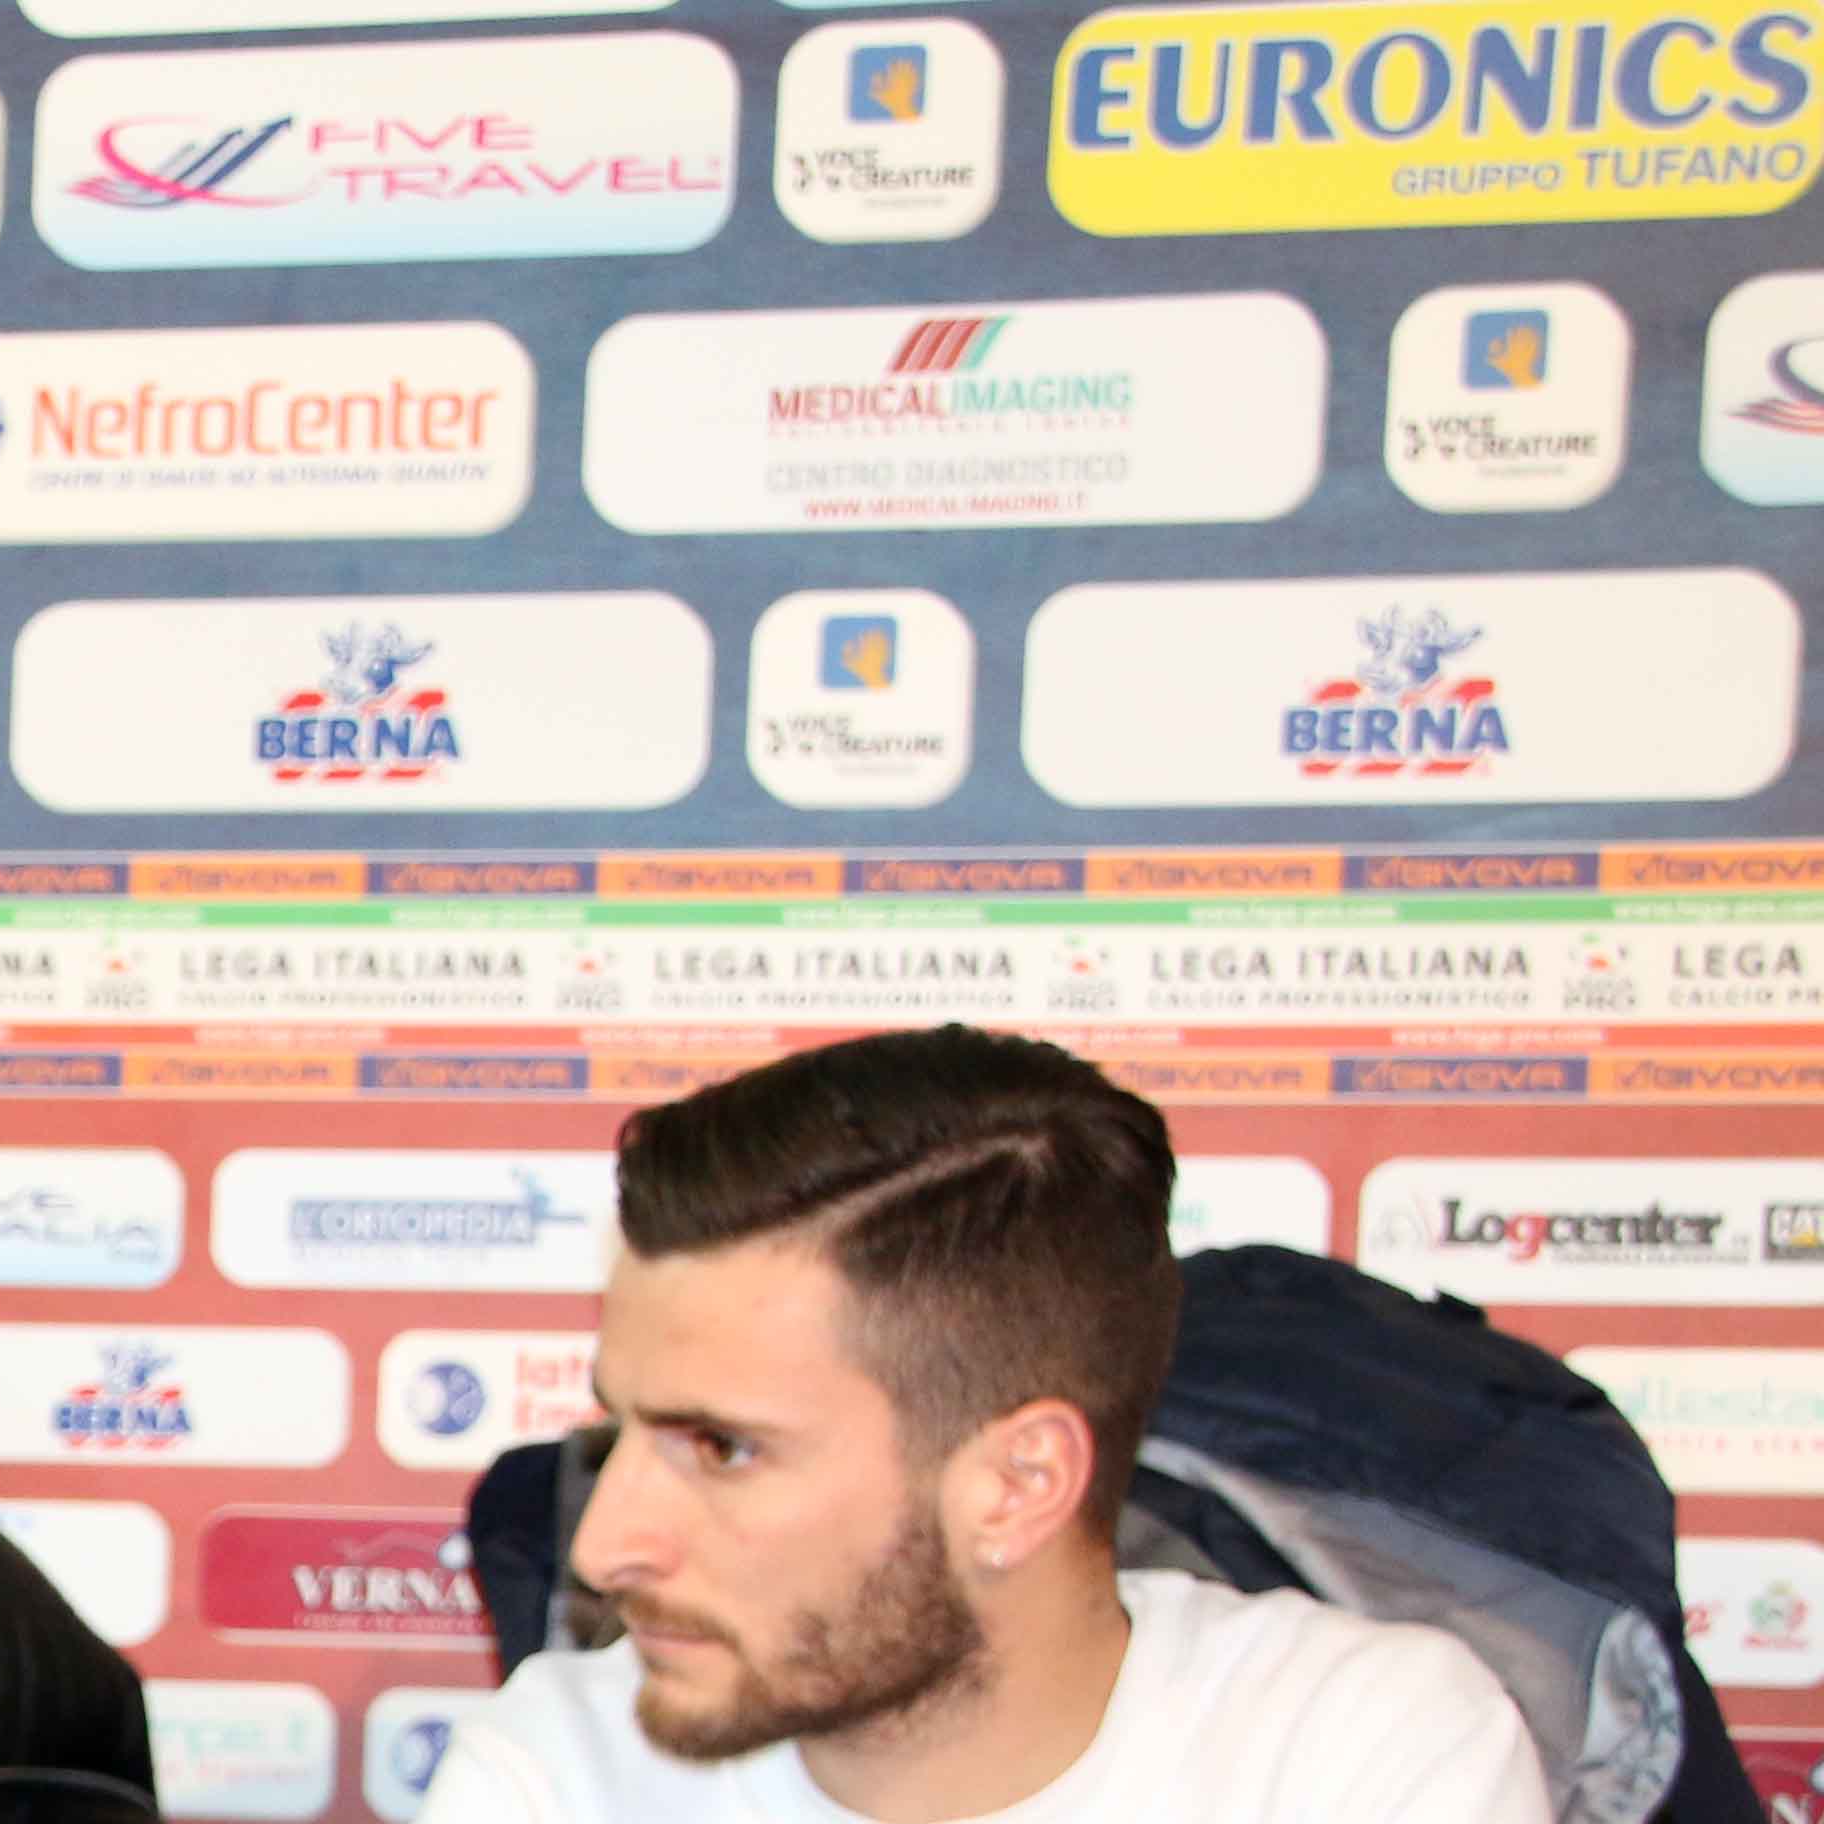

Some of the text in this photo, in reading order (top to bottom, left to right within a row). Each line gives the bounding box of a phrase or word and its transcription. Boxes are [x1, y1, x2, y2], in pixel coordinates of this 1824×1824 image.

[1066, 14, 1813, 151] EURONICS
[308, 114, 534, 154] FIVE
[324, 156, 726, 203] TRAVEL
[1392, 142, 1808, 198] GRUPPO TUFANO
[30, 377, 499, 459] NefroCenter
[768, 371, 1135, 422] MEDICAL IMAGING
[1427, 415, 1497, 437] VOCE
[1465, 433, 1599, 458] CREATURE
[765, 452, 1132, 492] CENTRO DIAGNOSTICO
[255, 716, 460, 762] BERNA
[1282, 706, 1510, 754] BERNA
[177, 948, 527, 977] LEGA ITALIANA
[654, 947, 1016, 980] LEGA ITALIANA
[1150, 946, 1531, 981] LEGA ITALIANA
[1672, 944, 1804, 979] LEGA
[1441, 1200, 1723, 1261] Logcenter
[291, 1565, 481, 1613] VERNA
